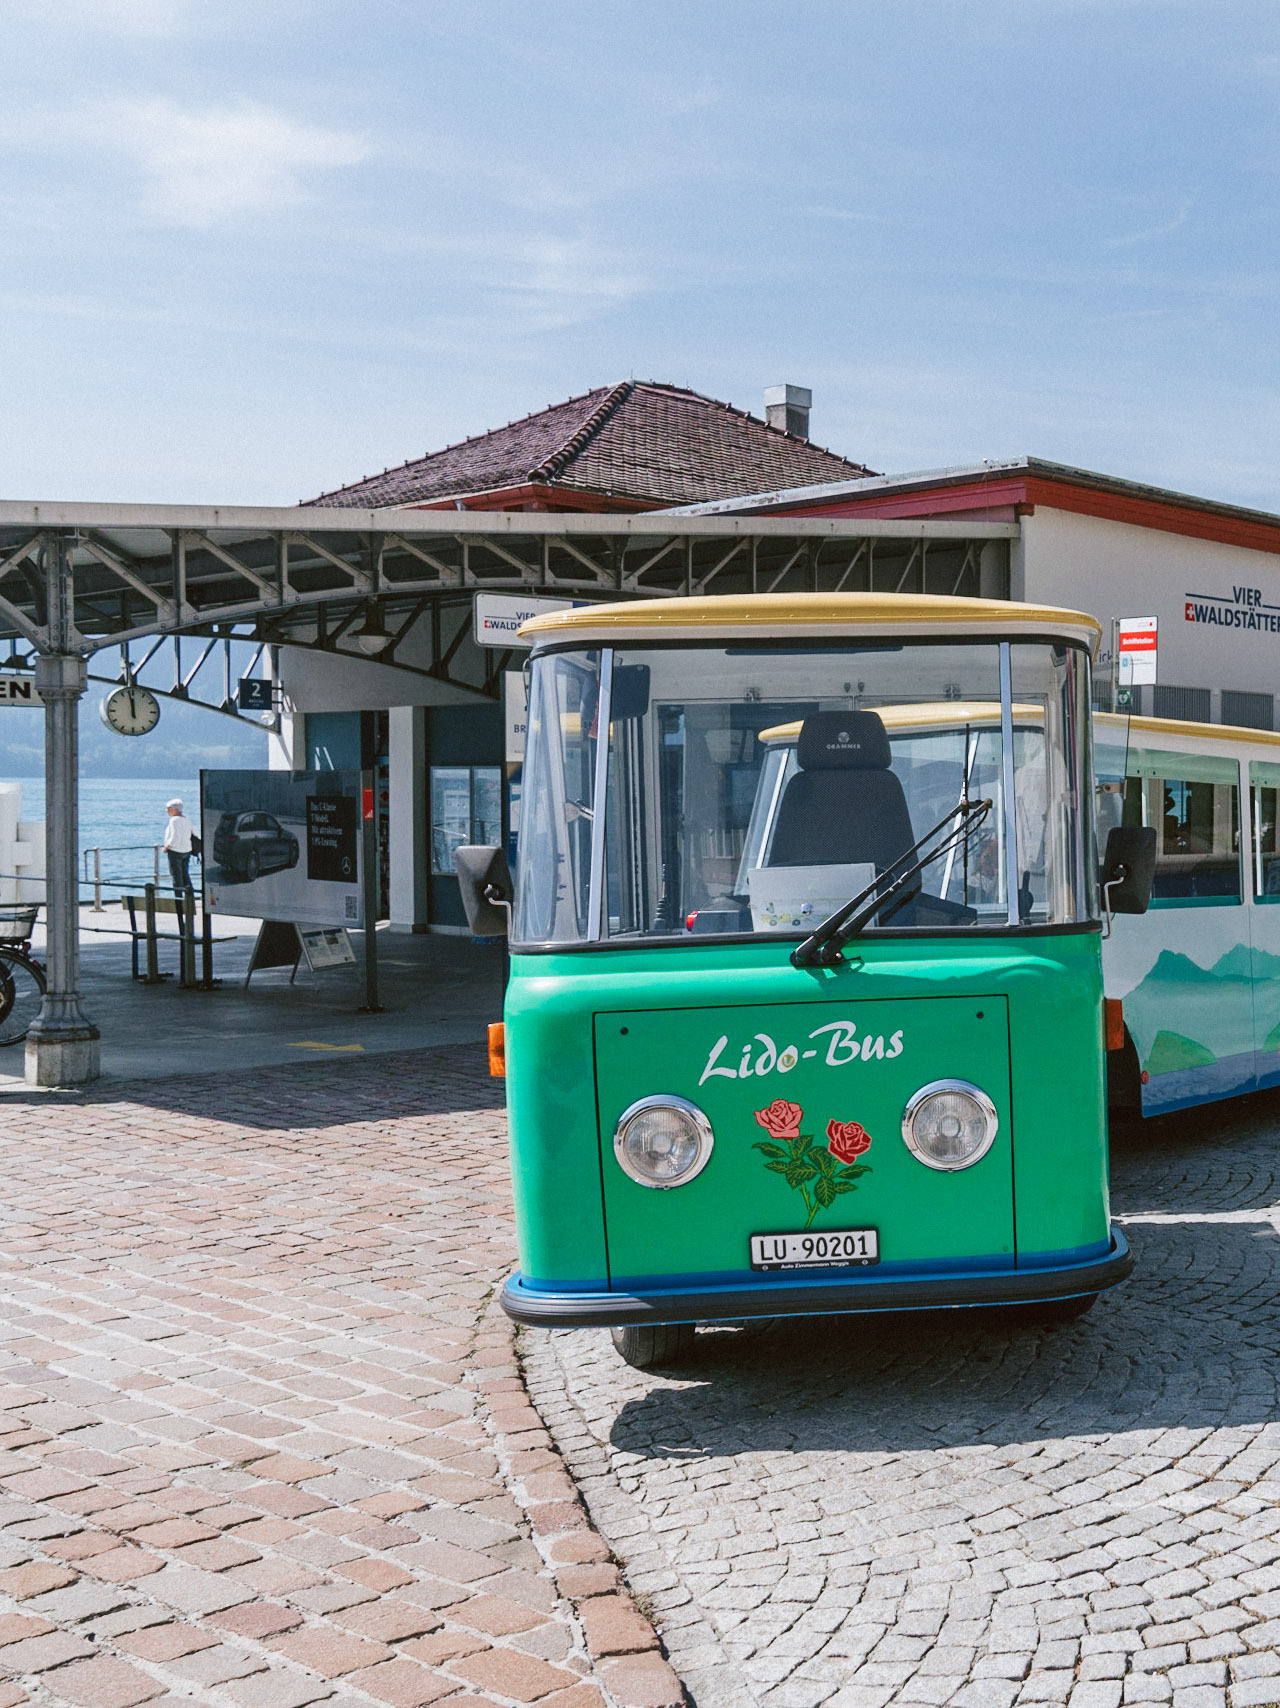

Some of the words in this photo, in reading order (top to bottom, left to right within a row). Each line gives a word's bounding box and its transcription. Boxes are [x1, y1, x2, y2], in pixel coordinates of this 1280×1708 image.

[1232, 586, 1262, 607] VIER
[251, 682, 261, 697] 2
[698, 1020, 904, 1087] Lido-Bus
